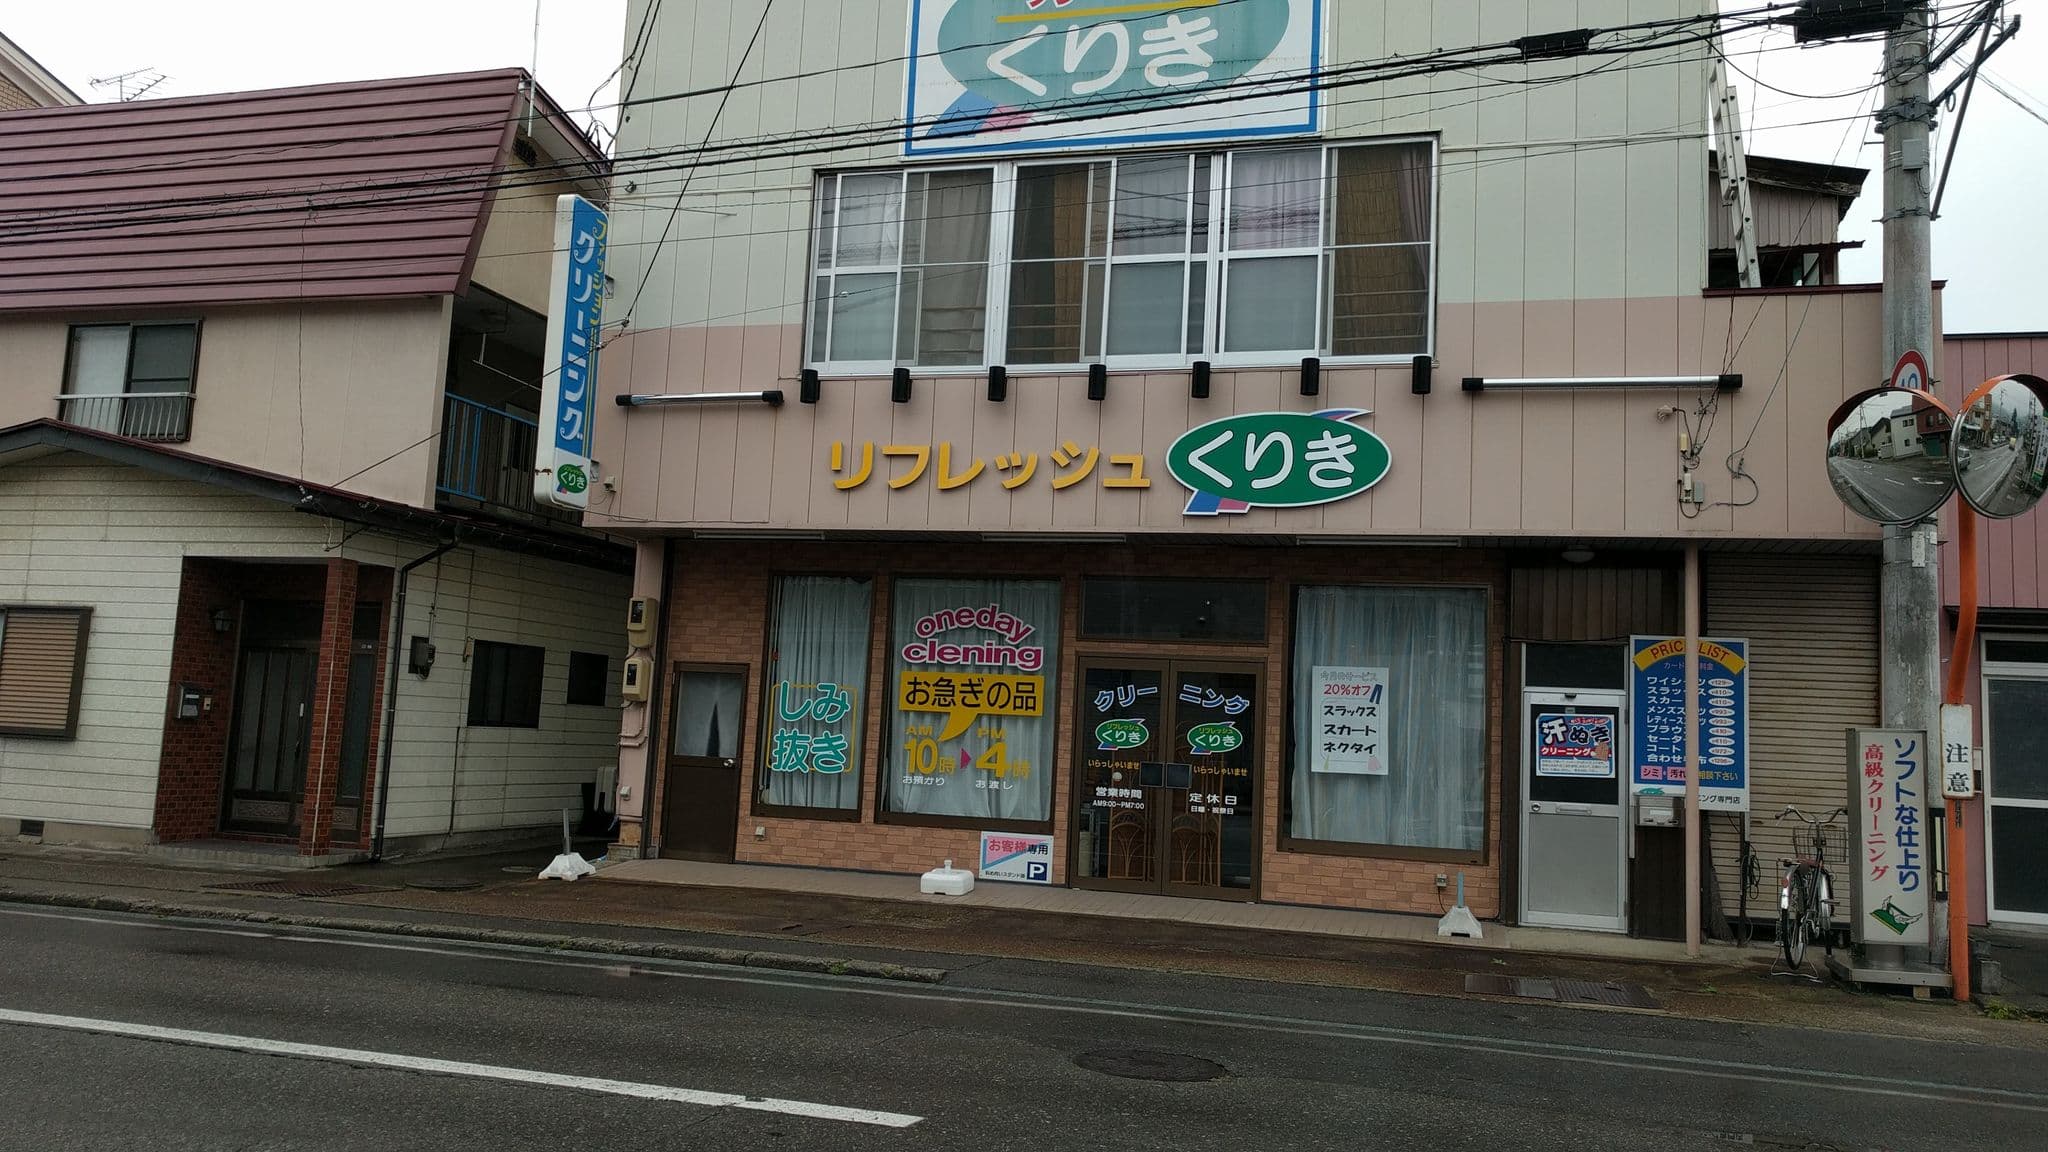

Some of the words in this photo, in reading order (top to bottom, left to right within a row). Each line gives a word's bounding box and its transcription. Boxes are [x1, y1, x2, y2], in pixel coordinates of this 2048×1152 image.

[987, 14, 1218, 96] くりき
[560, 229, 595, 441] クリーニング
[830, 441, 1151, 490] リフレッシュ
[1188, 430, 1356, 488] くりき
[560, 471, 585, 489] くりき
[914, 602, 1036, 643] oneday
[902, 640, 1044, 671] clening
[1650, 640, 1687, 659] PRIC
[1698, 643, 1730, 661] LIST
[1647, 677, 1706, 686] ワイシツ
[905, 676, 1037, 712] お急ぎの品
[1323, 683, 1372, 696] 20%オフ
[1647, 686, 1707, 696] スラッス
[778, 680, 850, 722] しみ
[1094, 684, 1158, 712] クリー
[1323, 705, 1377, 717] スラックス
[904, 725, 933, 736] AM
[977, 727, 1007, 739] PM
[1102, 729, 1142, 744] くりき
[1324, 724, 1377, 736] スカート
[1540, 716, 1611, 745] 汗ぬき
[1195, 733, 1236, 747] くりき
[1647, 734, 1686, 743] セータ
[771, 728, 848, 774] 抜き
[1323, 742, 1377, 754] ネクタイ
[1541, 747, 1592, 756] クリーニング
[1647, 744, 1681, 753] コート
[1088, 759, 1140, 770] いらっしゃいませ
[1193, 765, 1248, 776] いらっしゃいませ
[1945, 743, 1970, 793] 注意
[902, 775, 946, 786] お預かり
[975, 779, 1013, 790] お渡し
[1095, 786, 1143, 800] 営業時間
[1189, 792, 1238, 806] 定休日
[1864, 743, 1890, 882] 高級クリーニング
[1894, 737, 1922, 892] ソフトな仕上り
[988, 839, 1049, 856] お客様専用
[1029, 863, 1045, 878] P
